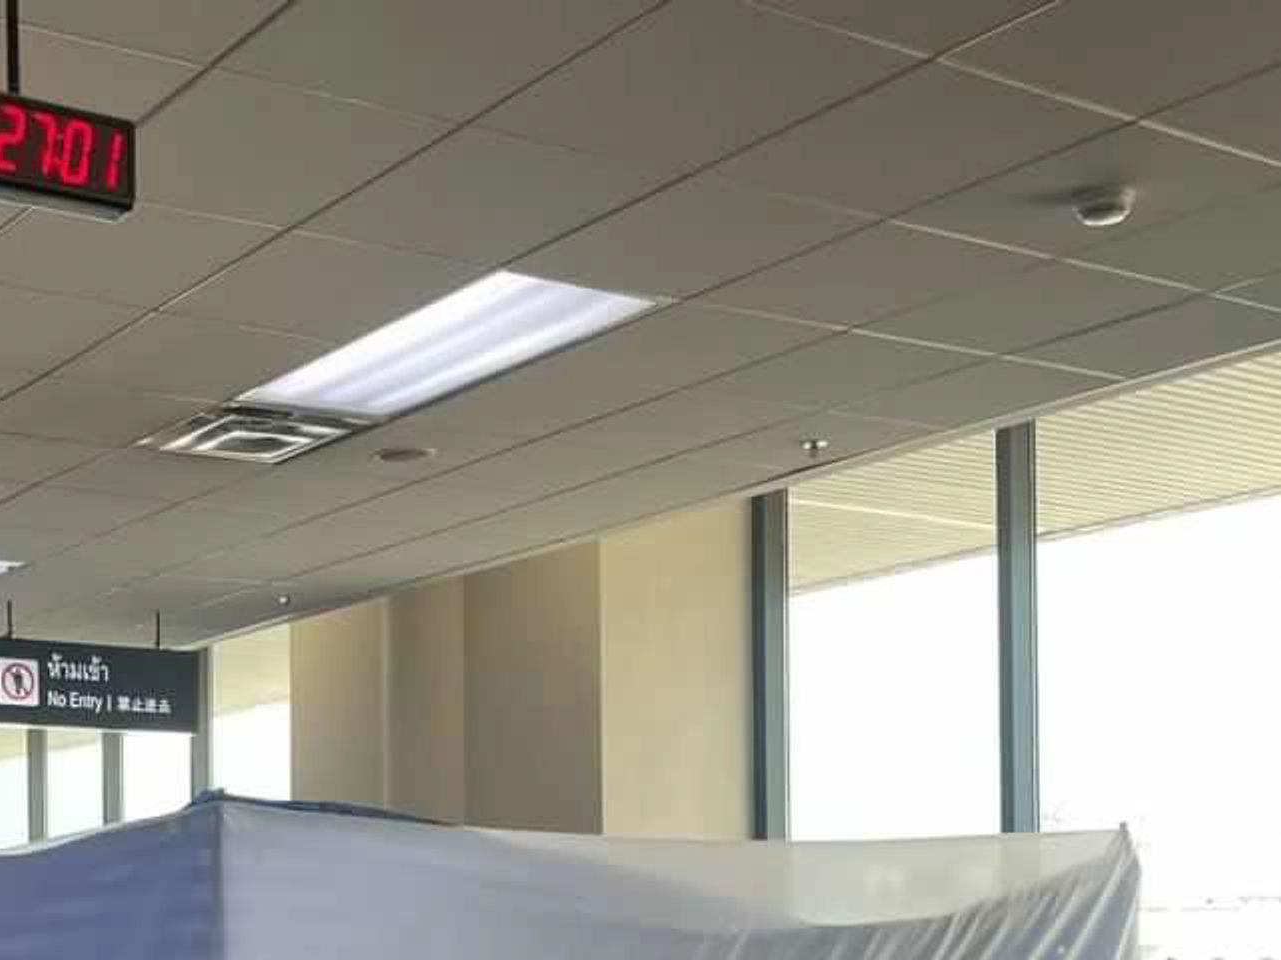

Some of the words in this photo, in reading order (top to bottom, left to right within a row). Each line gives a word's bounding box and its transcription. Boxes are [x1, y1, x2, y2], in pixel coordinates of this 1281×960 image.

[47, 652, 109, 682] ห้ามเข้า
[47, 690, 67, 707] No
[70, 691, 103, 714] Entry
